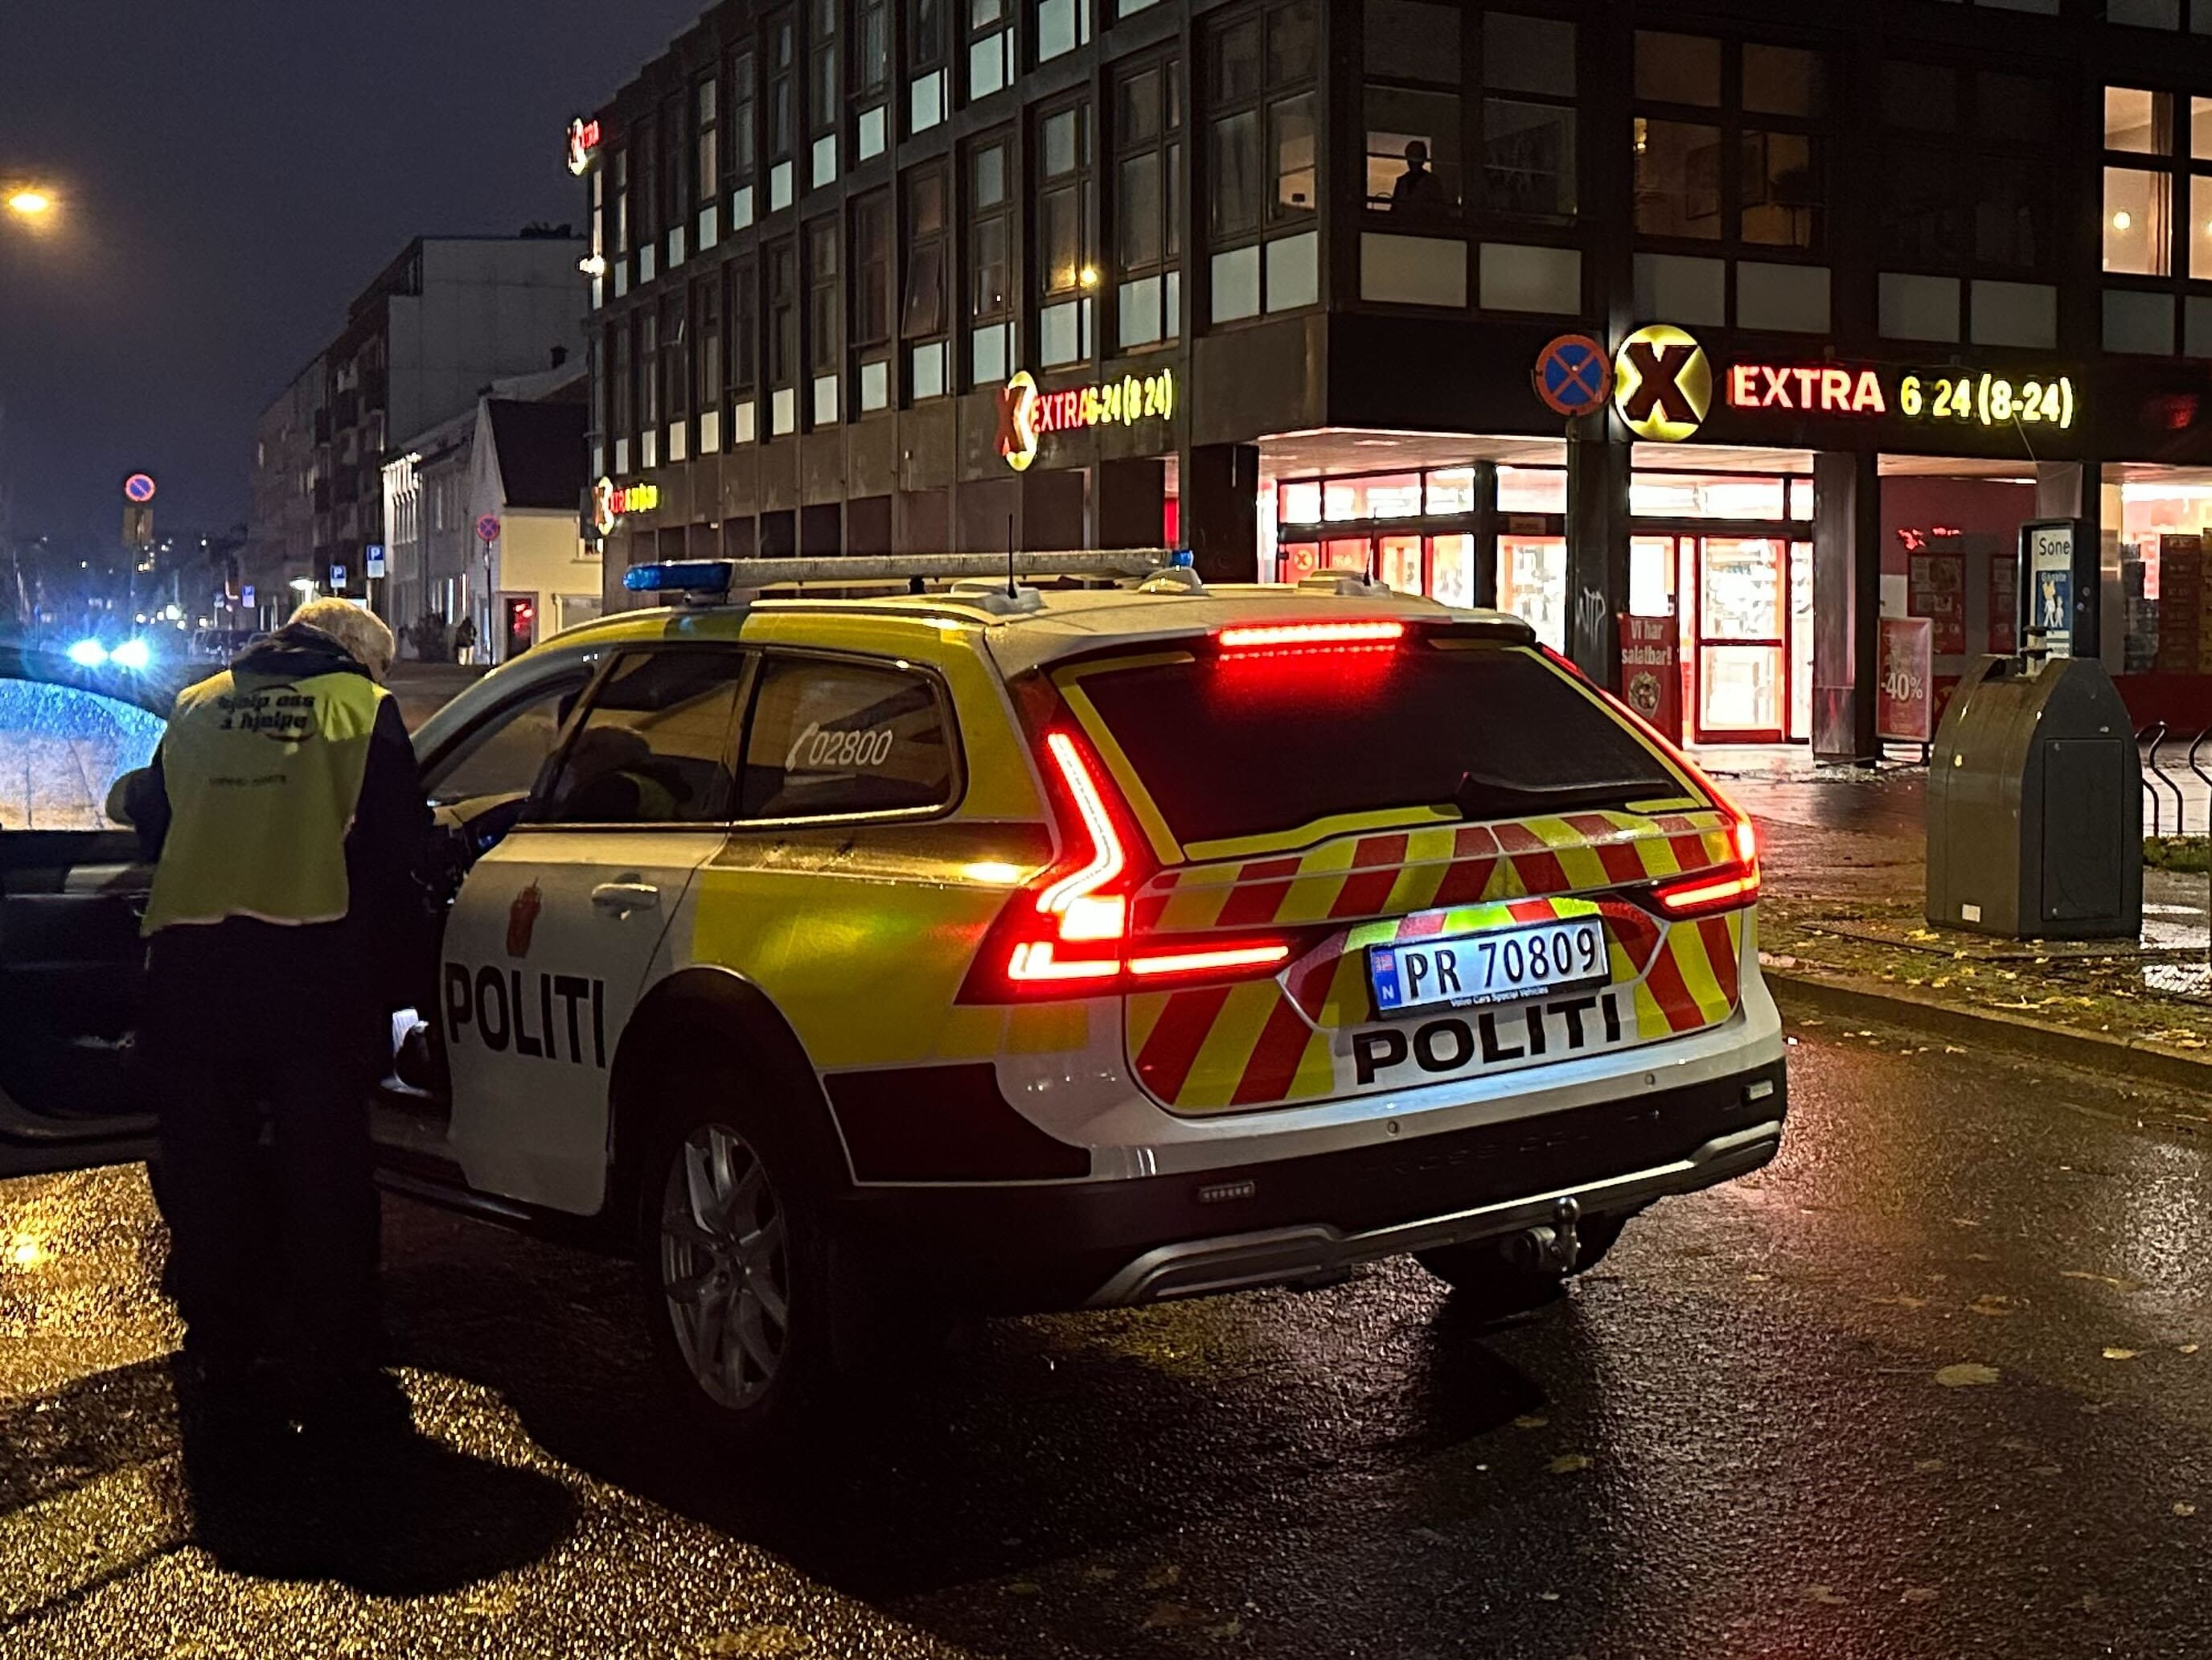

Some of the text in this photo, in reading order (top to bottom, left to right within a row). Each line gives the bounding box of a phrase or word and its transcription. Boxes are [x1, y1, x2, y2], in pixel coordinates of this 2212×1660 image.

[1623, 342, 1701, 425] X
[1727, 364, 1886, 413] EXTRA
[1978, 373, 2074, 429] (8-24)
[370, 547, 380, 561] P
[2038, 536, 2070, 556] Sone
[334, 569, 343, 579] P
[1631, 619, 1664, 640] Vi har
[1622, 645, 1672, 666] salatbar!
[809, 729, 893, 766] 02800
[1404, 927, 1597, 1000] PR 70809
[1381, 984, 1395, 1000] N
[445, 962, 606, 1069] POLITI
[1352, 992, 1621, 1086] POLITI
